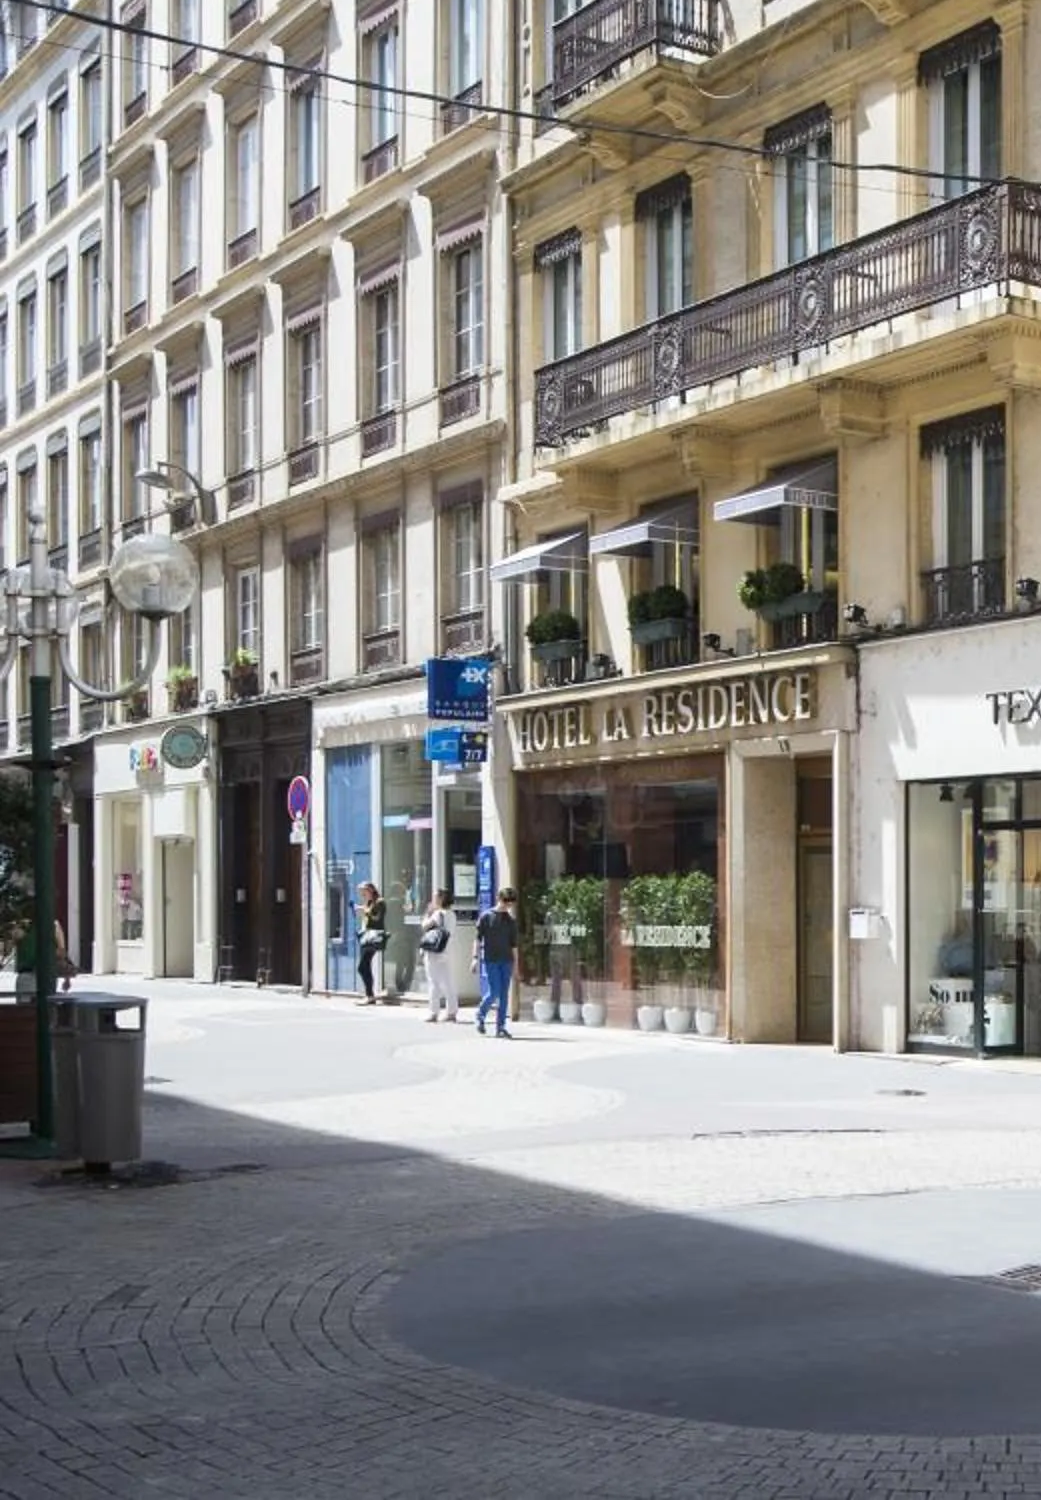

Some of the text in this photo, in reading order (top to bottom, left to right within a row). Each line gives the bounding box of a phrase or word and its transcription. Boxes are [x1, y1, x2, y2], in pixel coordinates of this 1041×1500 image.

[518, 672, 811, 752] HOTEL LA RESIDENCE
